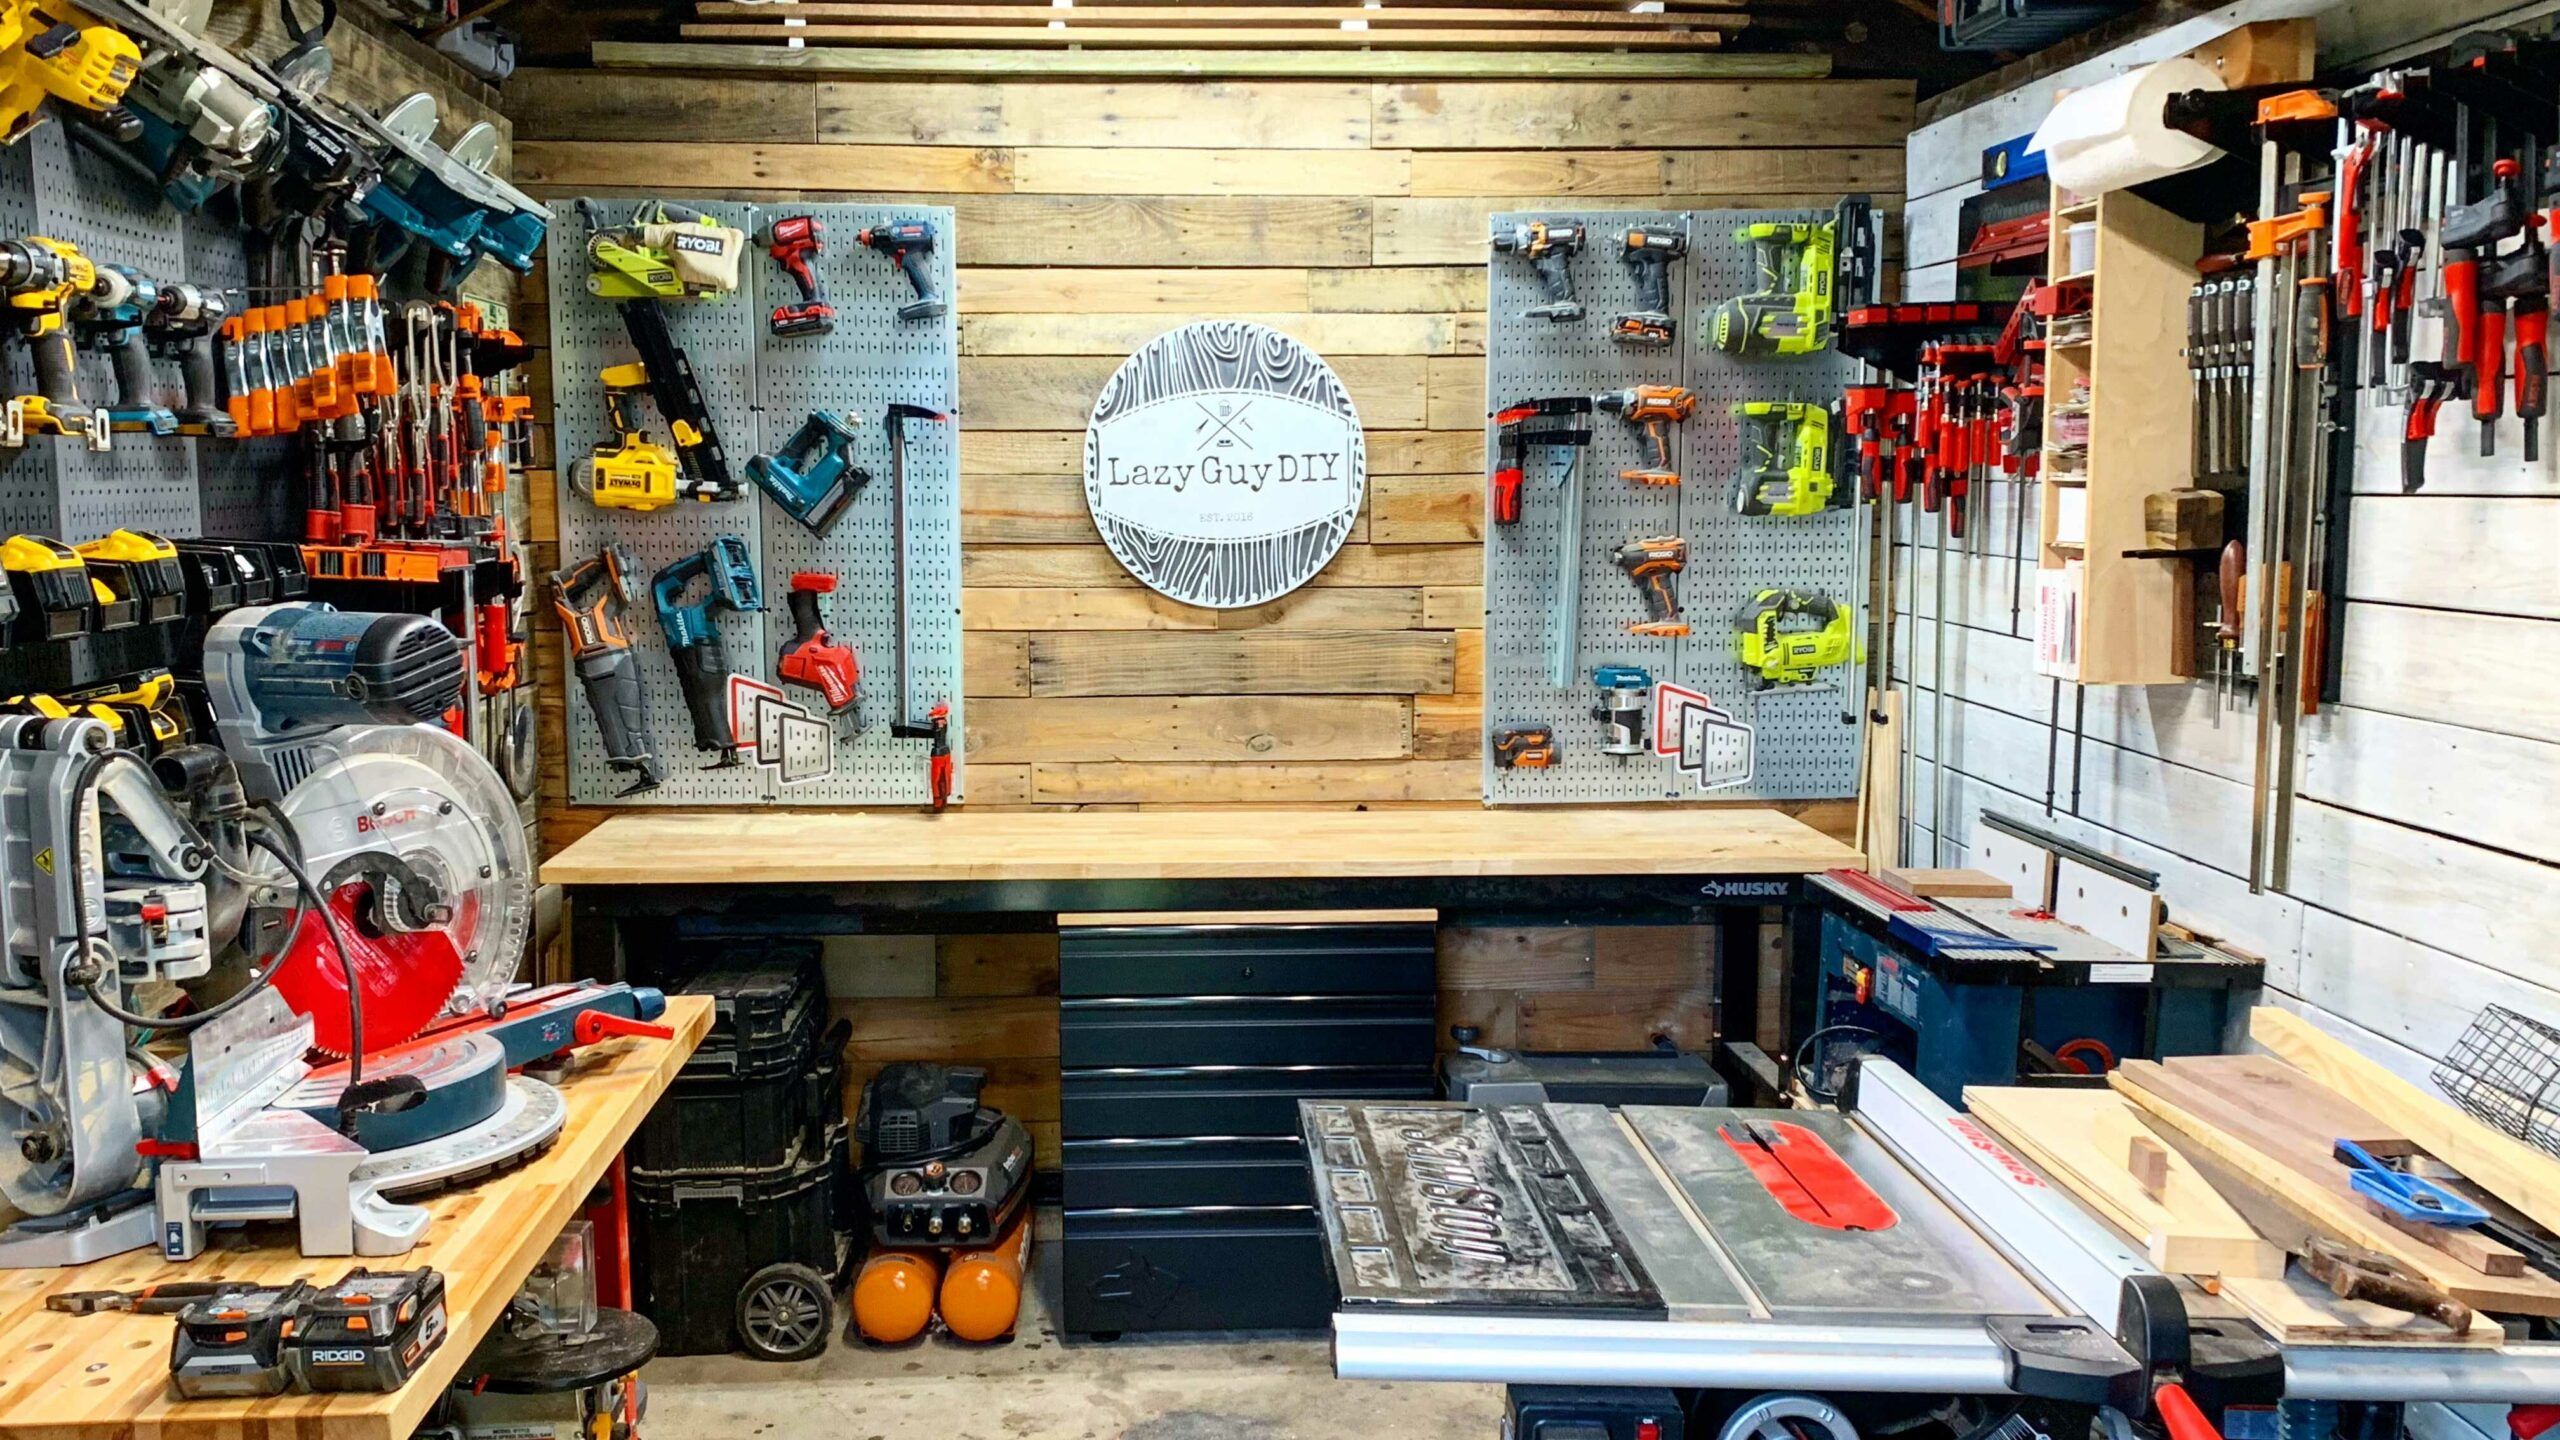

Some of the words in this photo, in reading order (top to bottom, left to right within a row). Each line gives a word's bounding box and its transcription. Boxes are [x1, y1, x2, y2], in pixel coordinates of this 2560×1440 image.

[676, 235, 722, 254] RYOBI
[1108, 457, 1195, 493] Lazy
[1201, 456, 1273, 492] Guy
[1278, 453, 1340, 482] DIY
[1199, 513, 1224, 523] EST.
[1724, 882, 1789, 896] HUSKY
[312, 1350, 365, 1362] RIDGID
